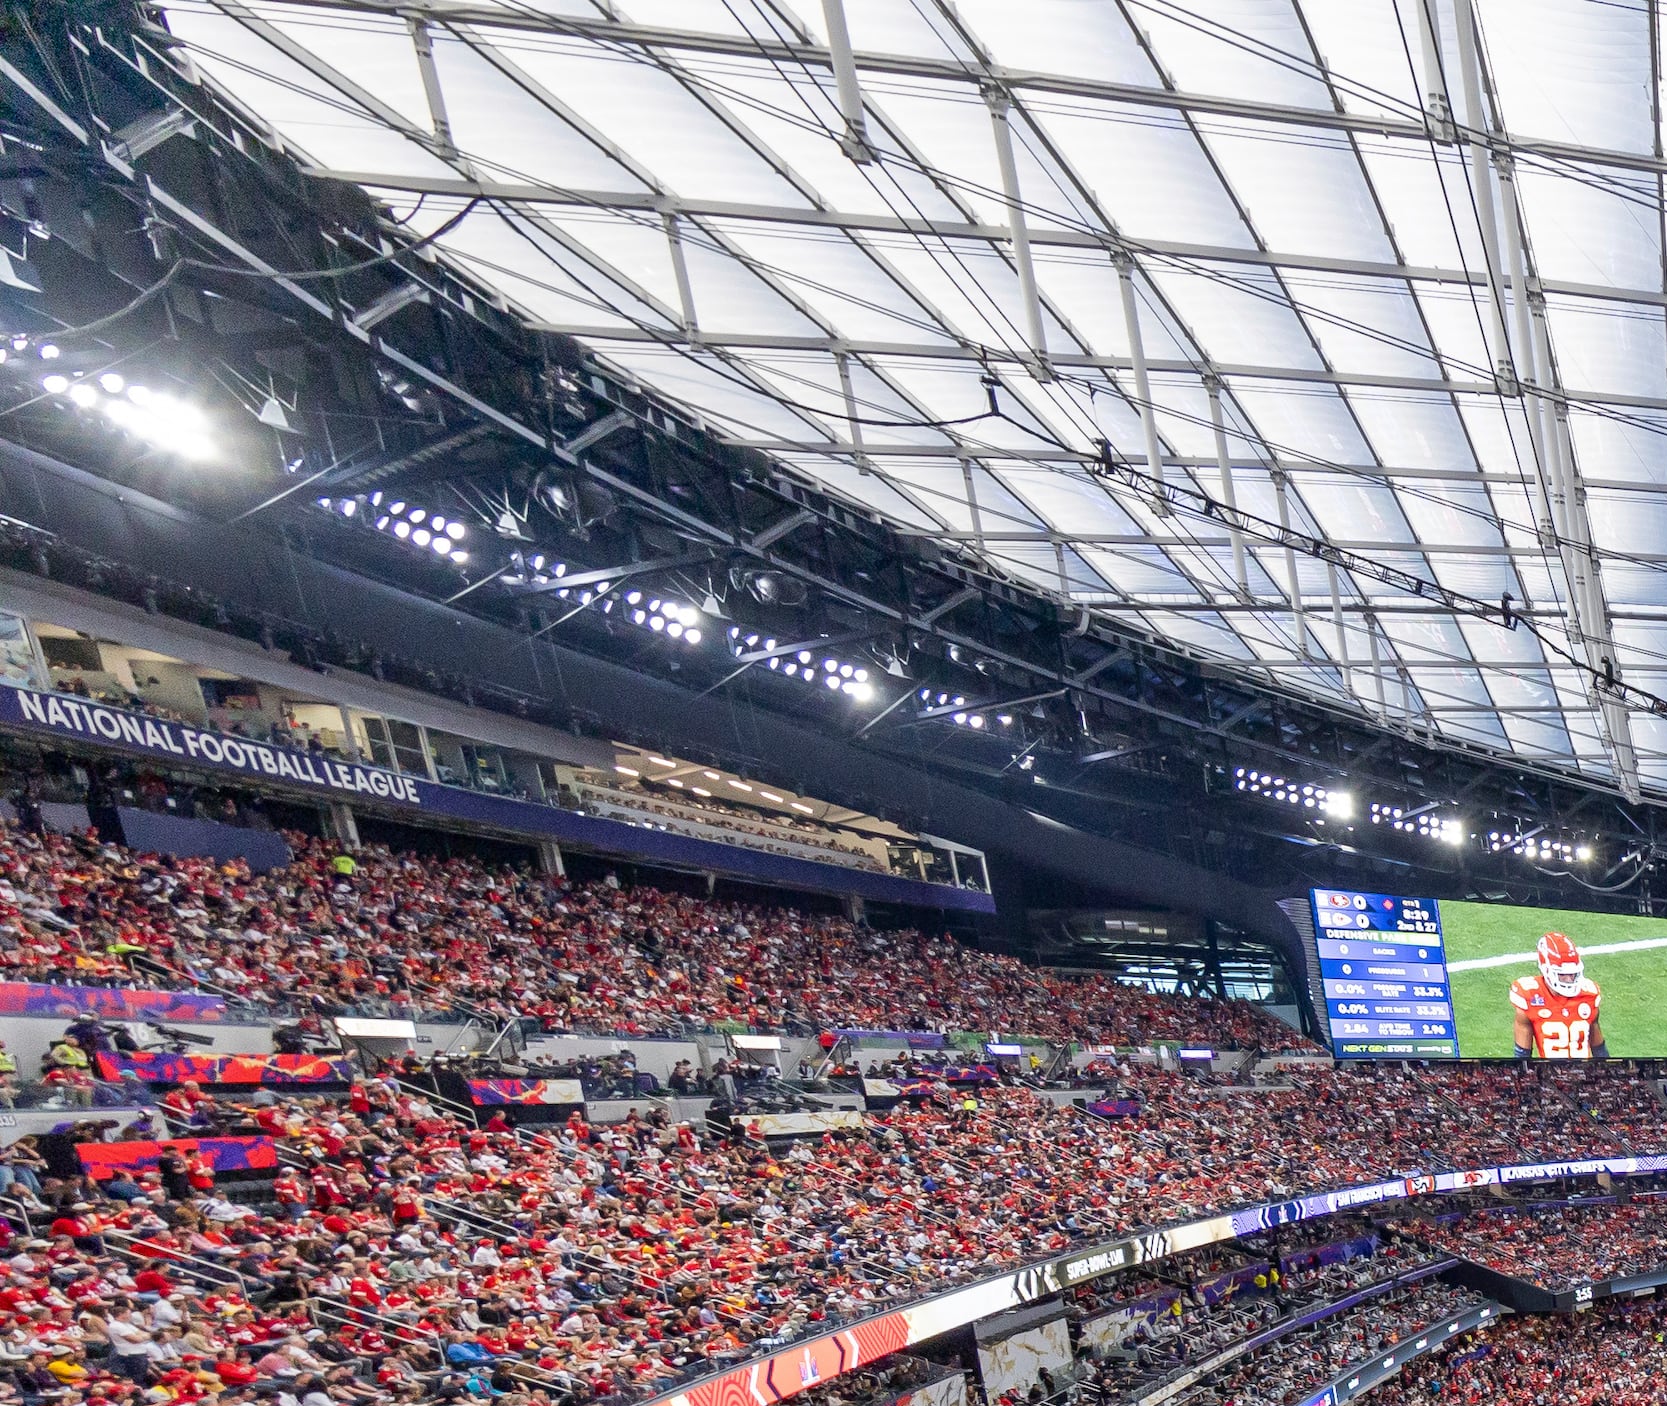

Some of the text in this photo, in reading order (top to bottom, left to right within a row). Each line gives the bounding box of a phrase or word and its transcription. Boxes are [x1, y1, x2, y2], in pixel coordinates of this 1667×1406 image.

[17, 690, 421, 804] NATIONAL FOOTBALL LEAGUE
[1326, 929, 1378, 941] DEFENSIVE
[1343, 1045, 1367, 1053] NEXT
[1541, 1020, 1590, 1058] 20
